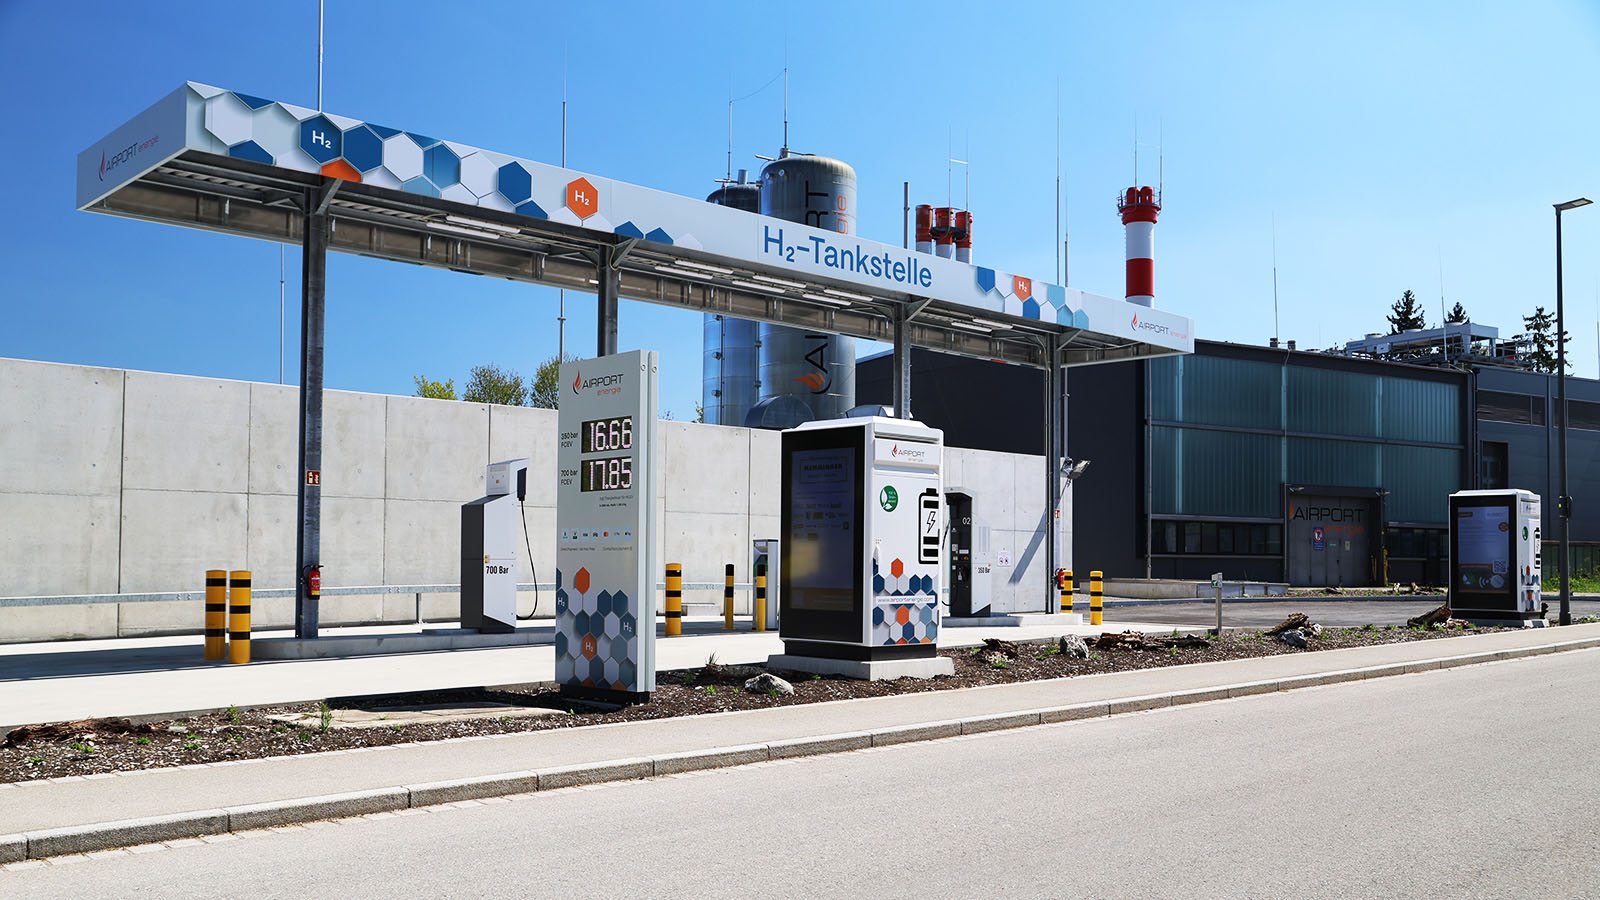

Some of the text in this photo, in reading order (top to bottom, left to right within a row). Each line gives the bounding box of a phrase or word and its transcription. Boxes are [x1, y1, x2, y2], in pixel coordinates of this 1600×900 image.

[105, 142, 138, 173] AIRPORT
[1138, 321, 1169, 334] AIRPORT
[581, 373, 625, 390] AIRPORT
[597, 387, 622, 396] energie
[571, 431, 579, 439] bar
[590, 418, 632, 451] 16.66
[898, 448, 925, 458] AIRPORT
[560, 469, 570, 477] 700
[590, 457, 632, 490] 17.85
[1293, 506, 1365, 522] AIRPORT
[962, 516, 972, 525] 02
[1324, 525, 1365, 537] energie
[486, 565, 509, 575] 700 Bar
